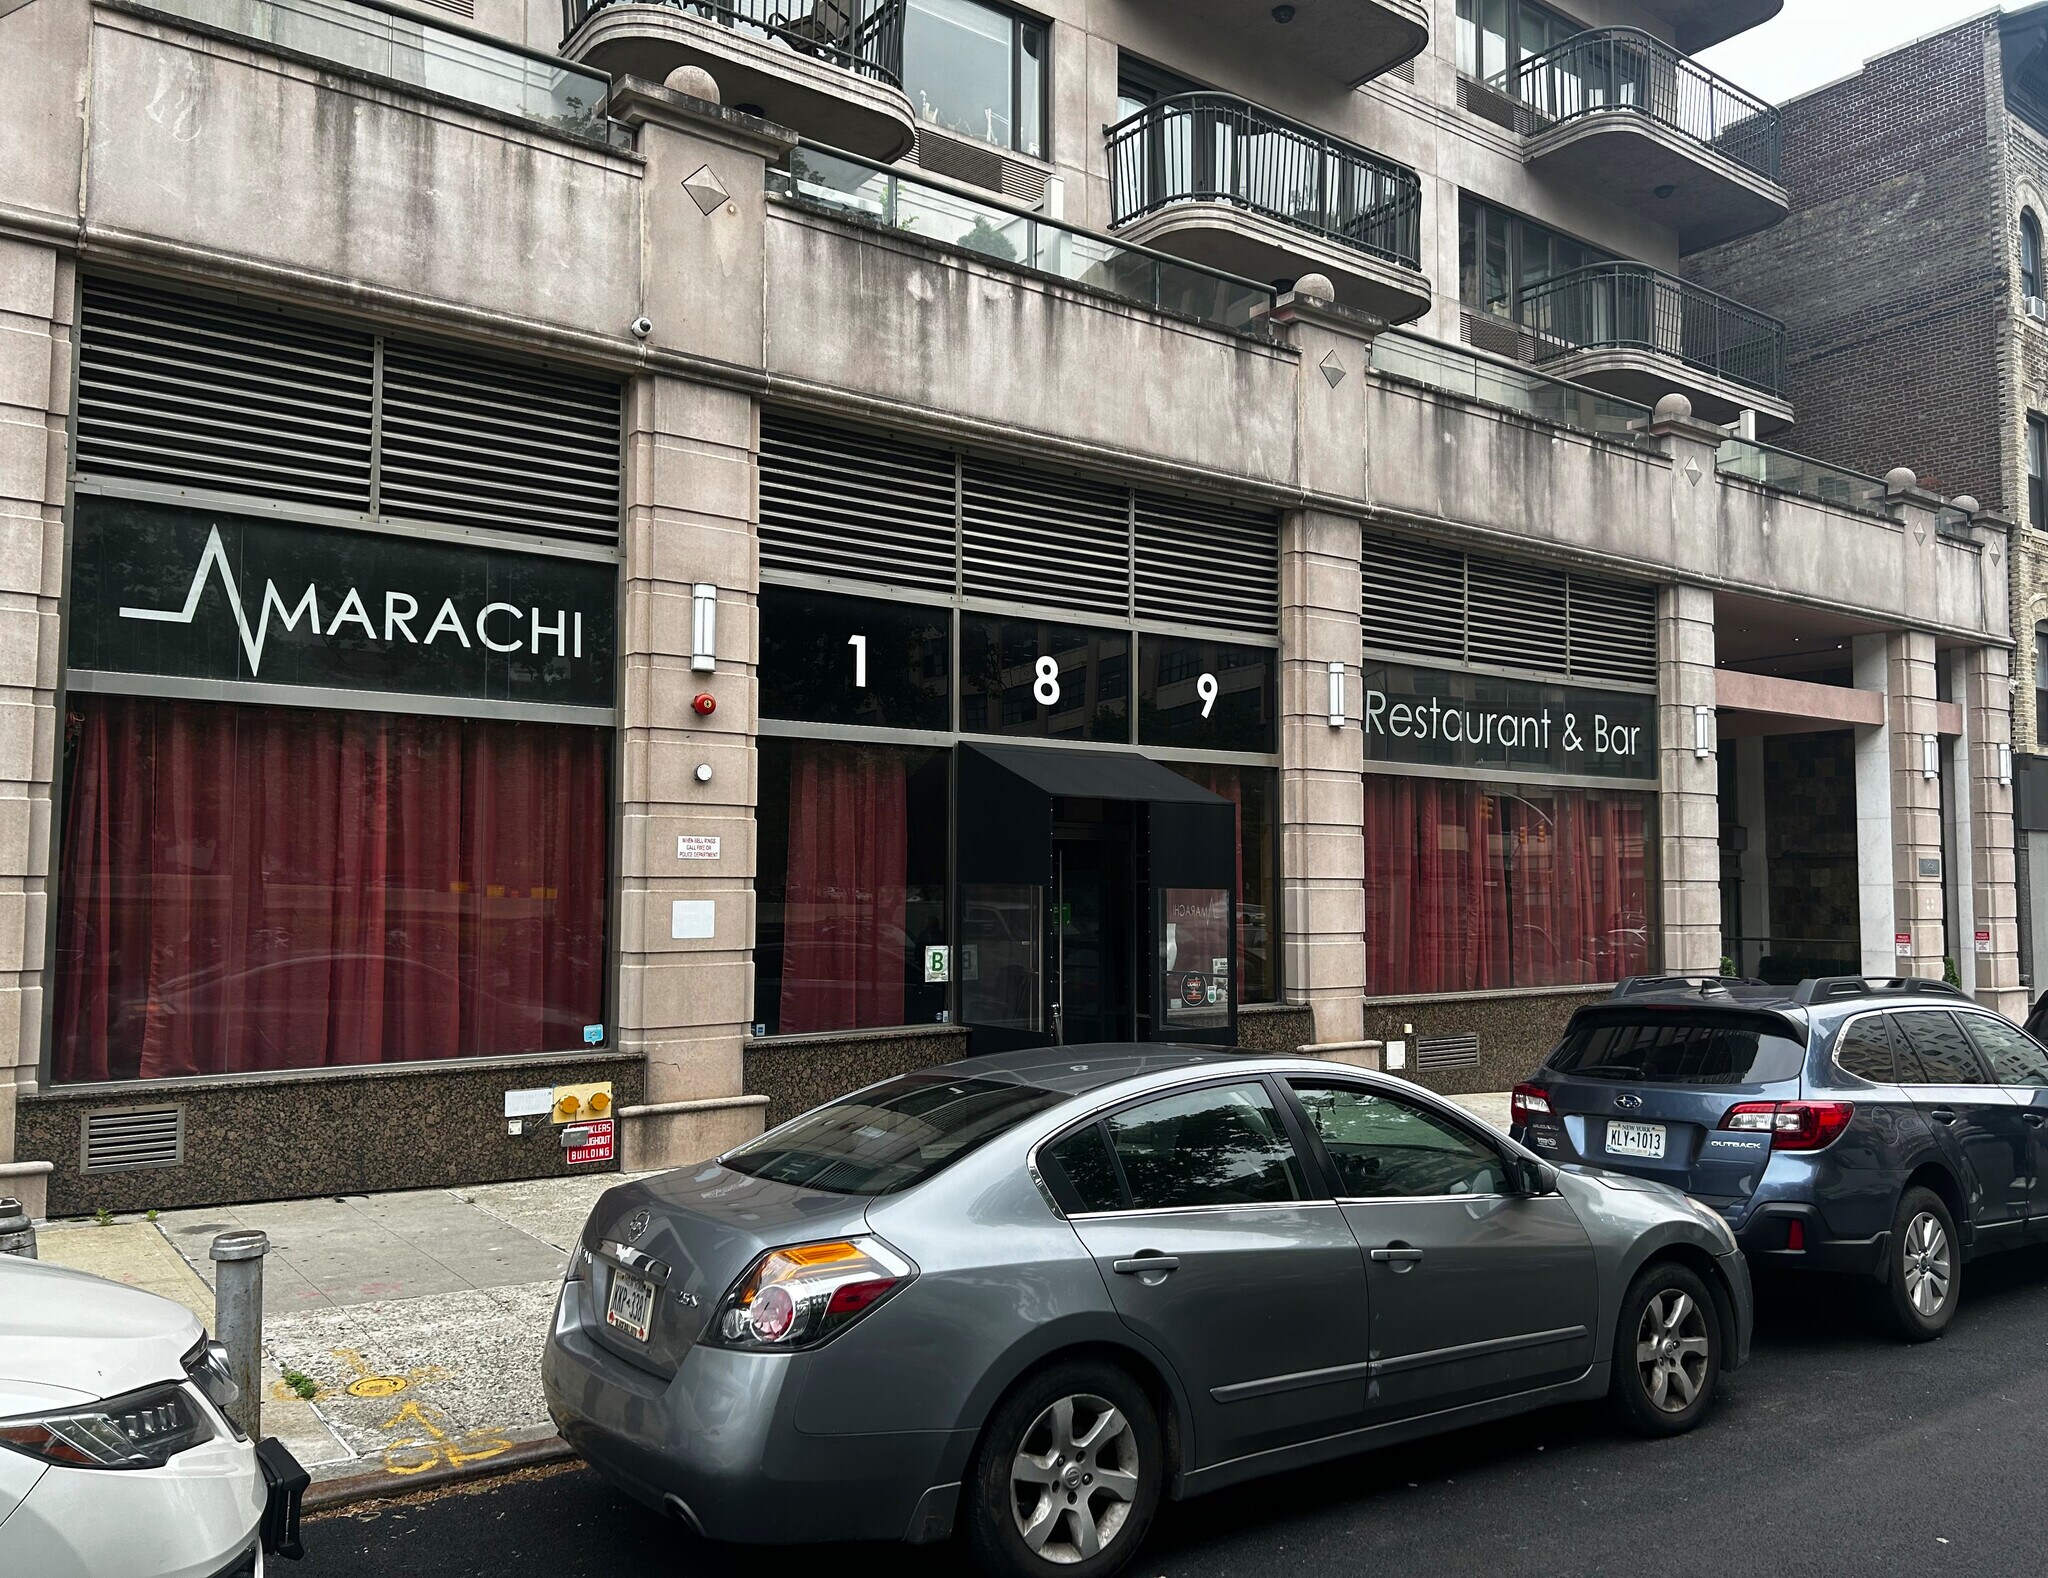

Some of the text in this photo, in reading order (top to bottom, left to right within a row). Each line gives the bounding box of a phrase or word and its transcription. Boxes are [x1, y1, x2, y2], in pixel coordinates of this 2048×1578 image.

[1365, 689, 1641, 755] Restaurant & Bar
[932, 951, 944, 971] B
[1635, 1125, 1651, 1133] YORK
[1711, 1140, 1761, 1149] OUTBACK
[571, 1147, 610, 1160] BUILDING
